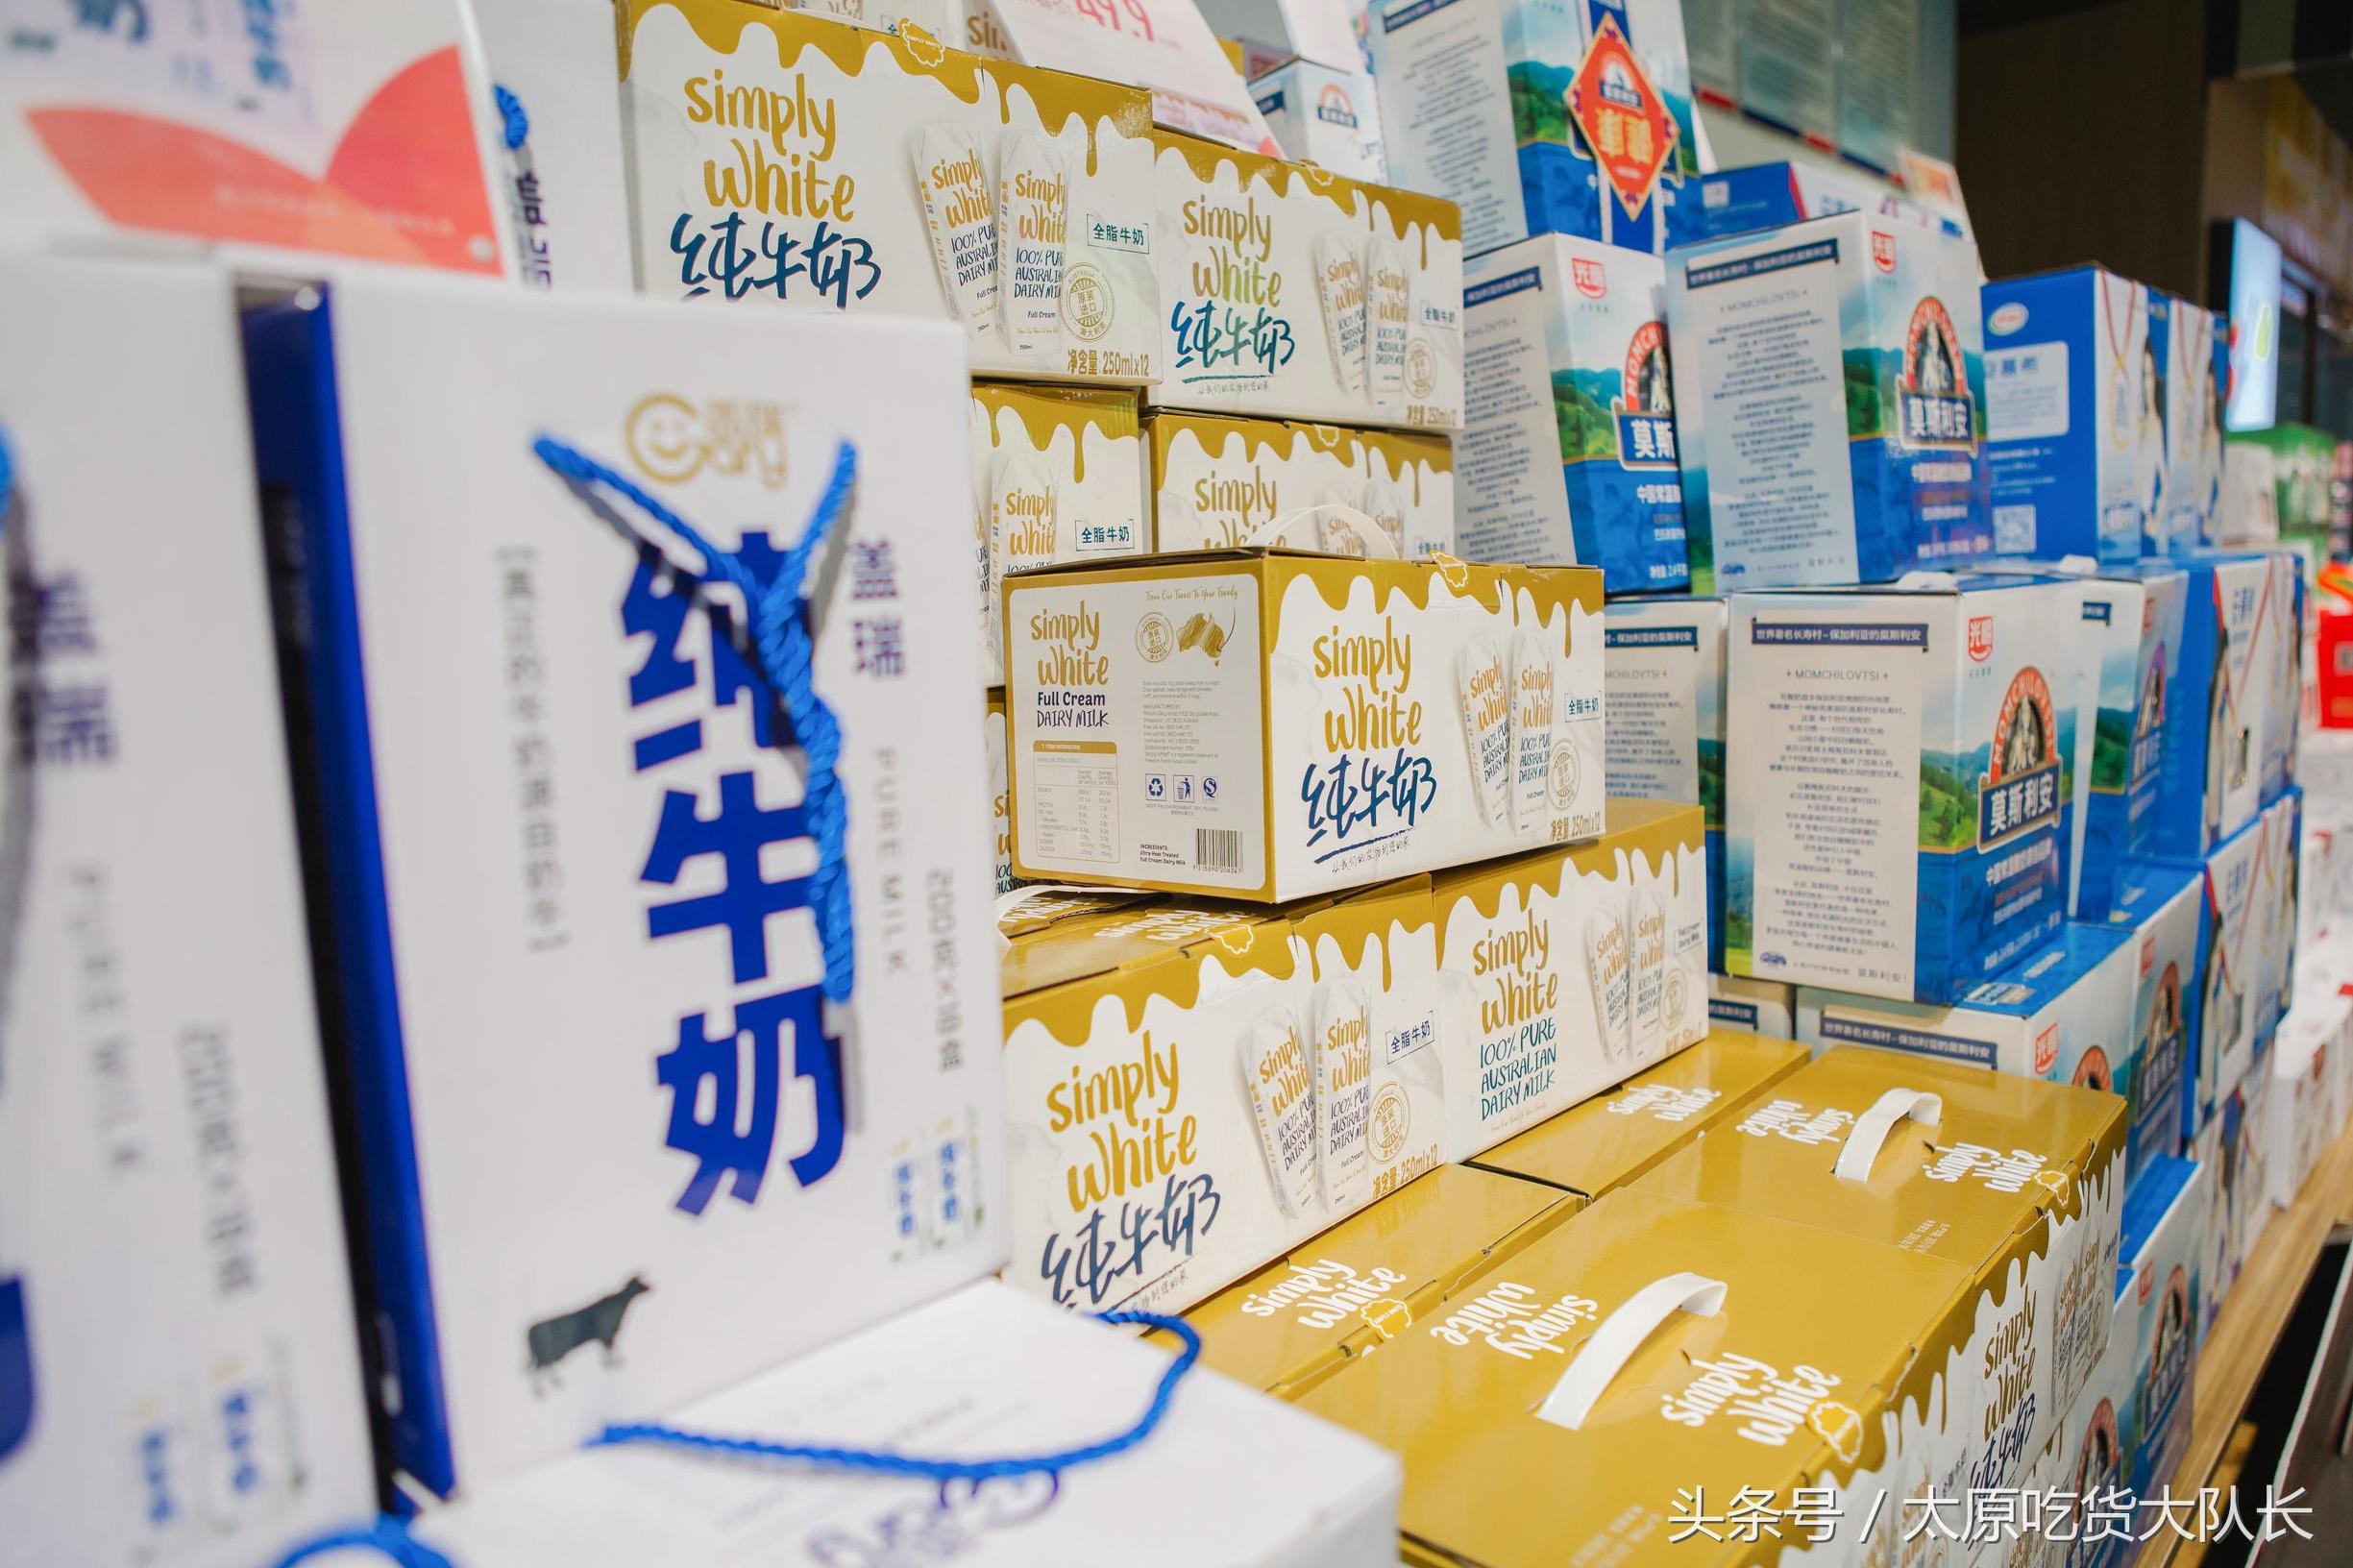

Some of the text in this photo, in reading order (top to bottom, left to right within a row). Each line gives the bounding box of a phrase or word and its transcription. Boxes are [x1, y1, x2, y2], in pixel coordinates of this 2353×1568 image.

[685, 69, 835, 161] simply
[703, 139, 855, 222] white
[1015, 170, 1066, 212] simply
[951, 223, 996, 253] 100% PUR
[1092, 222, 1144, 246] 全脂牛奶
[1183, 194, 1271, 262] simply
[671, 211, 882, 310] 纯牛奶
[955, 241, 997, 268] AUSTRALI
[958, 266, 987, 286] DAIRY
[1015, 265, 1063, 282] AUSTRALI
[1017, 247, 1063, 267] 100% PUR
[1192, 246, 1282, 307] white
[987, 285, 997, 296] Crea
[1015, 283, 1044, 299] DAIRY
[1028, 310, 1056, 319] Full Cream
[1171, 300, 1295, 374] 纯牛奶
[1630, 420, 1676, 458] 莫斯
[1194, 465, 1277, 527] simply
[1082, 526, 1130, 544] 全脂牛奶
[1030, 600, 1099, 652] simply
[1038, 644, 1109, 687] white
[1312, 615, 1410, 694] simply
[1795, 670, 1880, 682] MOMCHILOVTSI
[1037, 709, 1109, 728] DAIRY MILK
[1038, 692, 1106, 707] Full Cream
[1324, 684, 1423, 753] white
[1478, 690, 1507, 731] whit
[1523, 694, 1552, 728] whit
[1568, 698, 1599, 716] 全脂牛奶
[1520, 749, 1550, 767] AUSTRALI
[1301, 747, 1437, 847] 纯牛奶
[1990, 772, 2054, 837] 莫斯利安
[620, 530, 847, 1216] 纯牛奶
[1473, 908, 1549, 977] simply
[1482, 970, 1557, 1035] white
[1391, 1019, 1431, 1054] 全脂牛奶
[1481, 1017, 1556, 1068] 100% PURE
[1046, 1030, 1179, 1133] simply
[1271, 1061, 1311, 1117] whit
[1482, 1045, 1556, 1094] AUSTRALIAN
[1278, 1091, 1314, 1140] 100% PUR
[1331, 1085, 1369, 1118] 100% PUR
[1482, 1069, 1556, 1121] DAIRY MILK
[1606, 1084, 1682, 1115] simply
[1283, 1112, 1316, 1156] AUSTRALI
[1331, 1107, 1369, 1137] AUSTRALI
[1331, 1131, 1355, 1156] DAIRY
[1779, 1107, 1855, 1146] simply
[1067, 1115, 1196, 1213] white
[1284, 1139, 1308, 1171] DAIRY
[1924, 1142, 2000, 1184] simply
[1041, 1173, 1221, 1308] 纯牛奶
[1241, 1259, 1357, 1318] simply
[1297, 1265, 1407, 1330] white
[1485, 1295, 1598, 1360] simply
[1984, 1284, 2036, 1380] simply
[1661, 1352, 1777, 1427] simply
[1727, 1365, 1842, 1446] white
